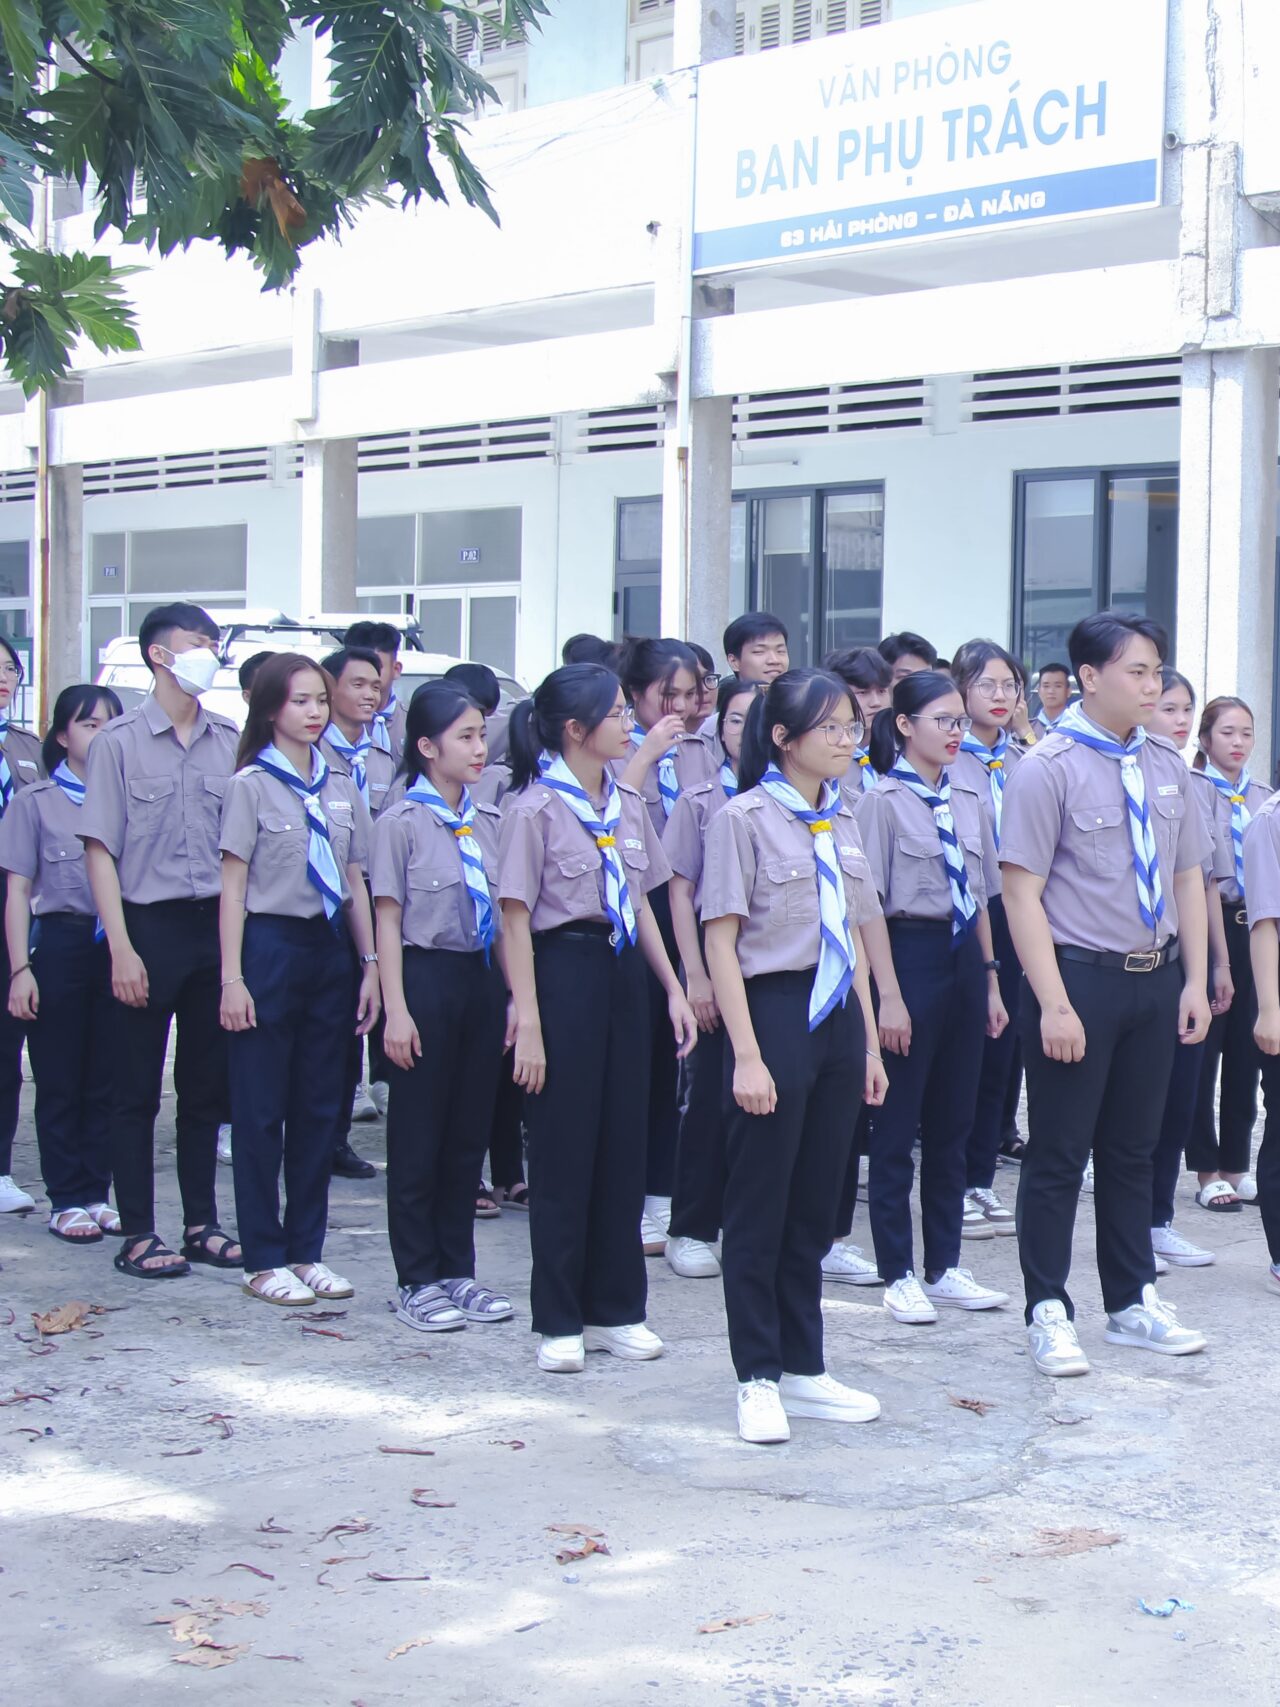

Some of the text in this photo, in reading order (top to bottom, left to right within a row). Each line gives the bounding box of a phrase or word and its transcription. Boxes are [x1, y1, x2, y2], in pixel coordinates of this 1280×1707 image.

[818, 40, 1012, 109] VĂN PHÒNG
[735, 80, 1107, 199] BAN PHỤ TRÁCH
[848, 211, 918, 237] PHÒNG
[943, 198, 975, 222] ĐÀ
